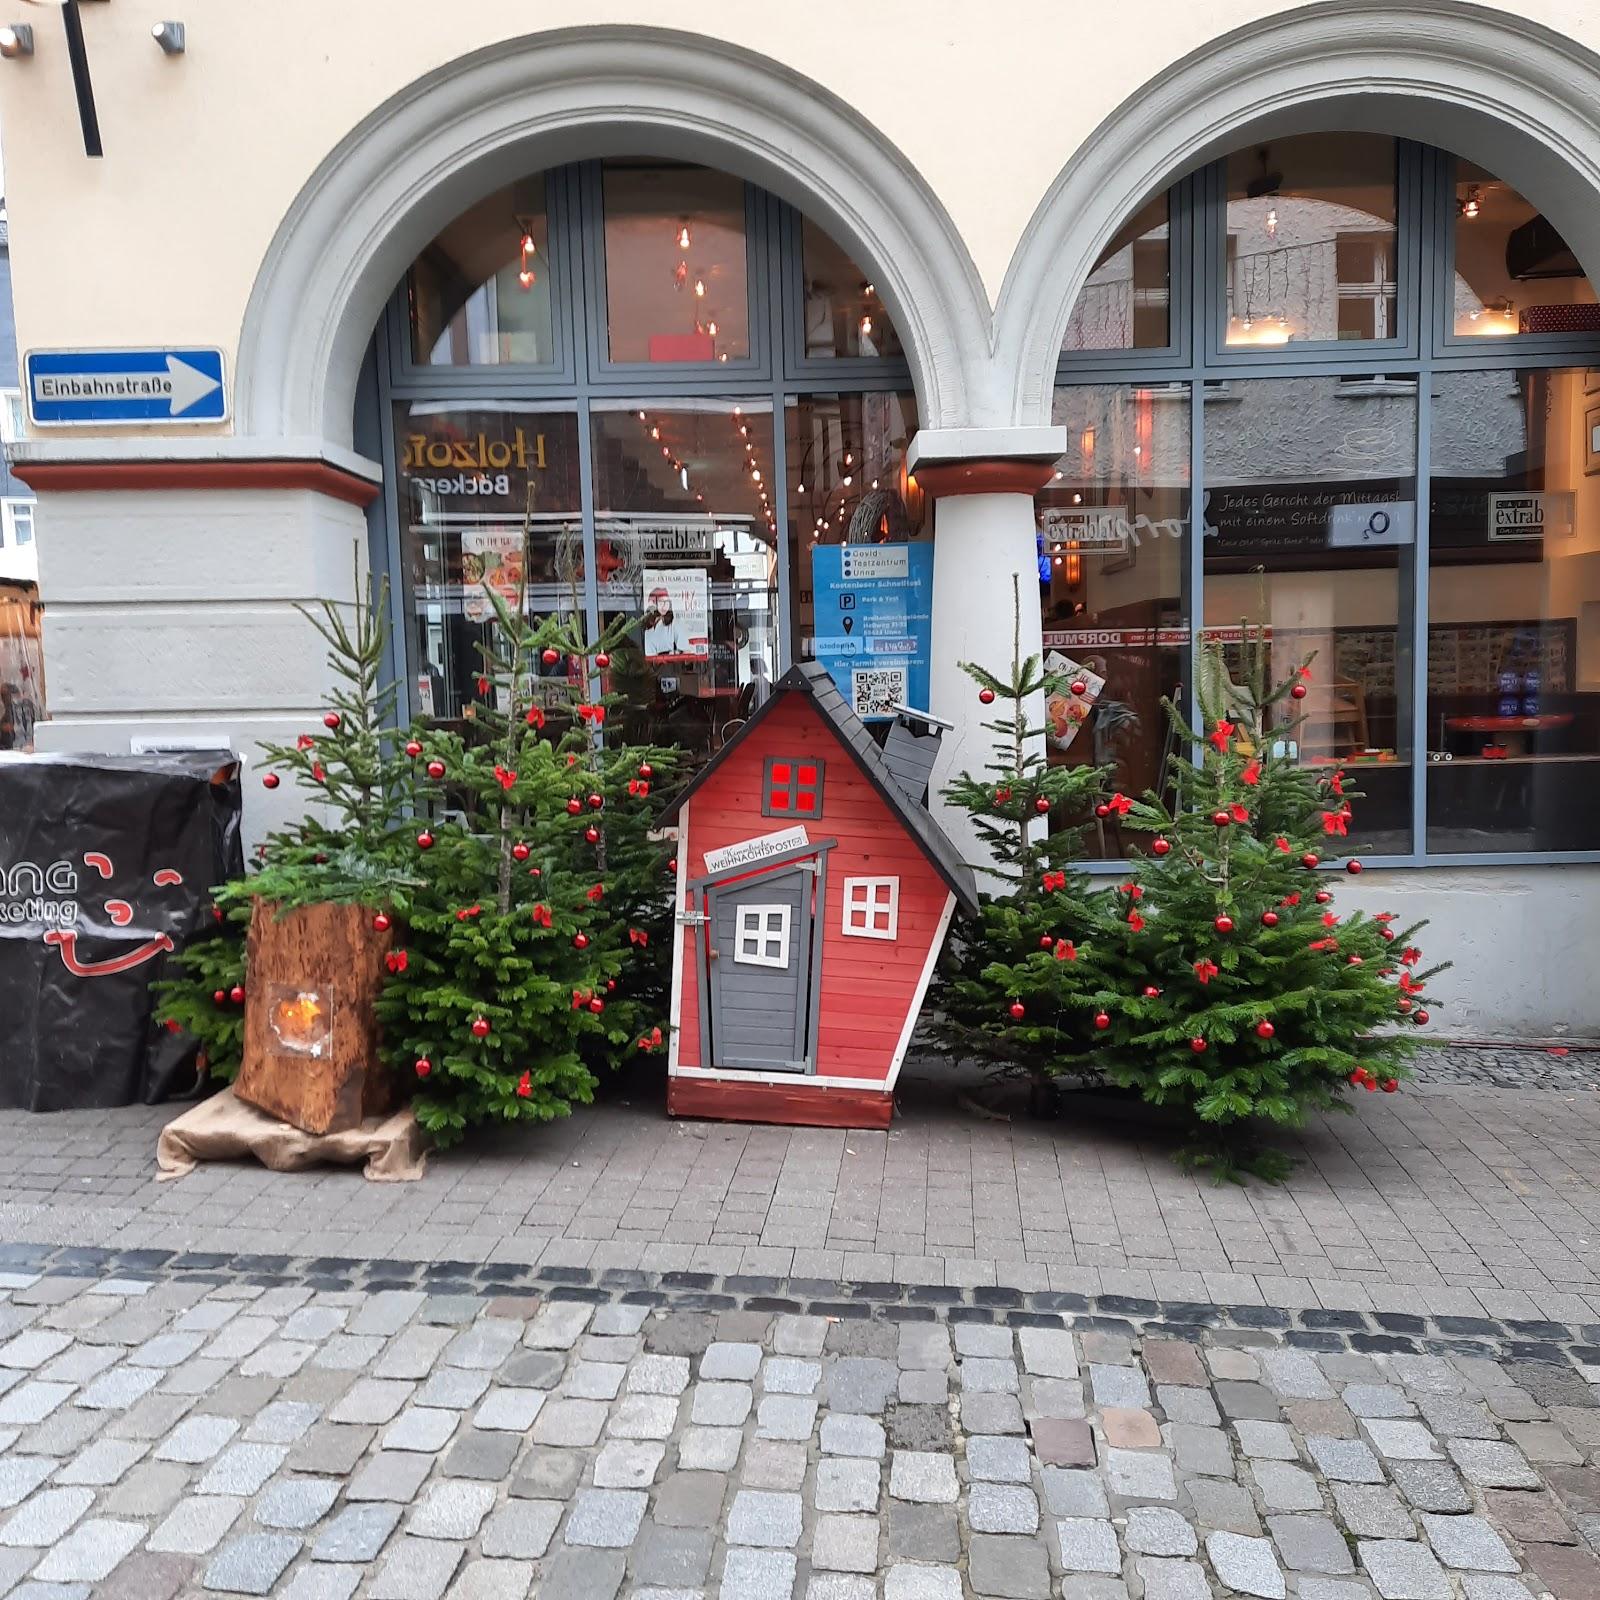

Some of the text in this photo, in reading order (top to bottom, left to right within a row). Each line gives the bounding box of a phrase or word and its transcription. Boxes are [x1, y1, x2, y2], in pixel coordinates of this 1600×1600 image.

[42, 377, 172, 396] Einbahnstraße
[1219, 493, 1258, 512] Jedes
[1262, 493, 1308, 508] Gericht
[1313, 492, 1336, 505] der
[1220, 518, 1241, 527] mit
[1246, 516, 1286, 528] einem
[710, 840, 794, 870] WEIHNACHTSPOST
